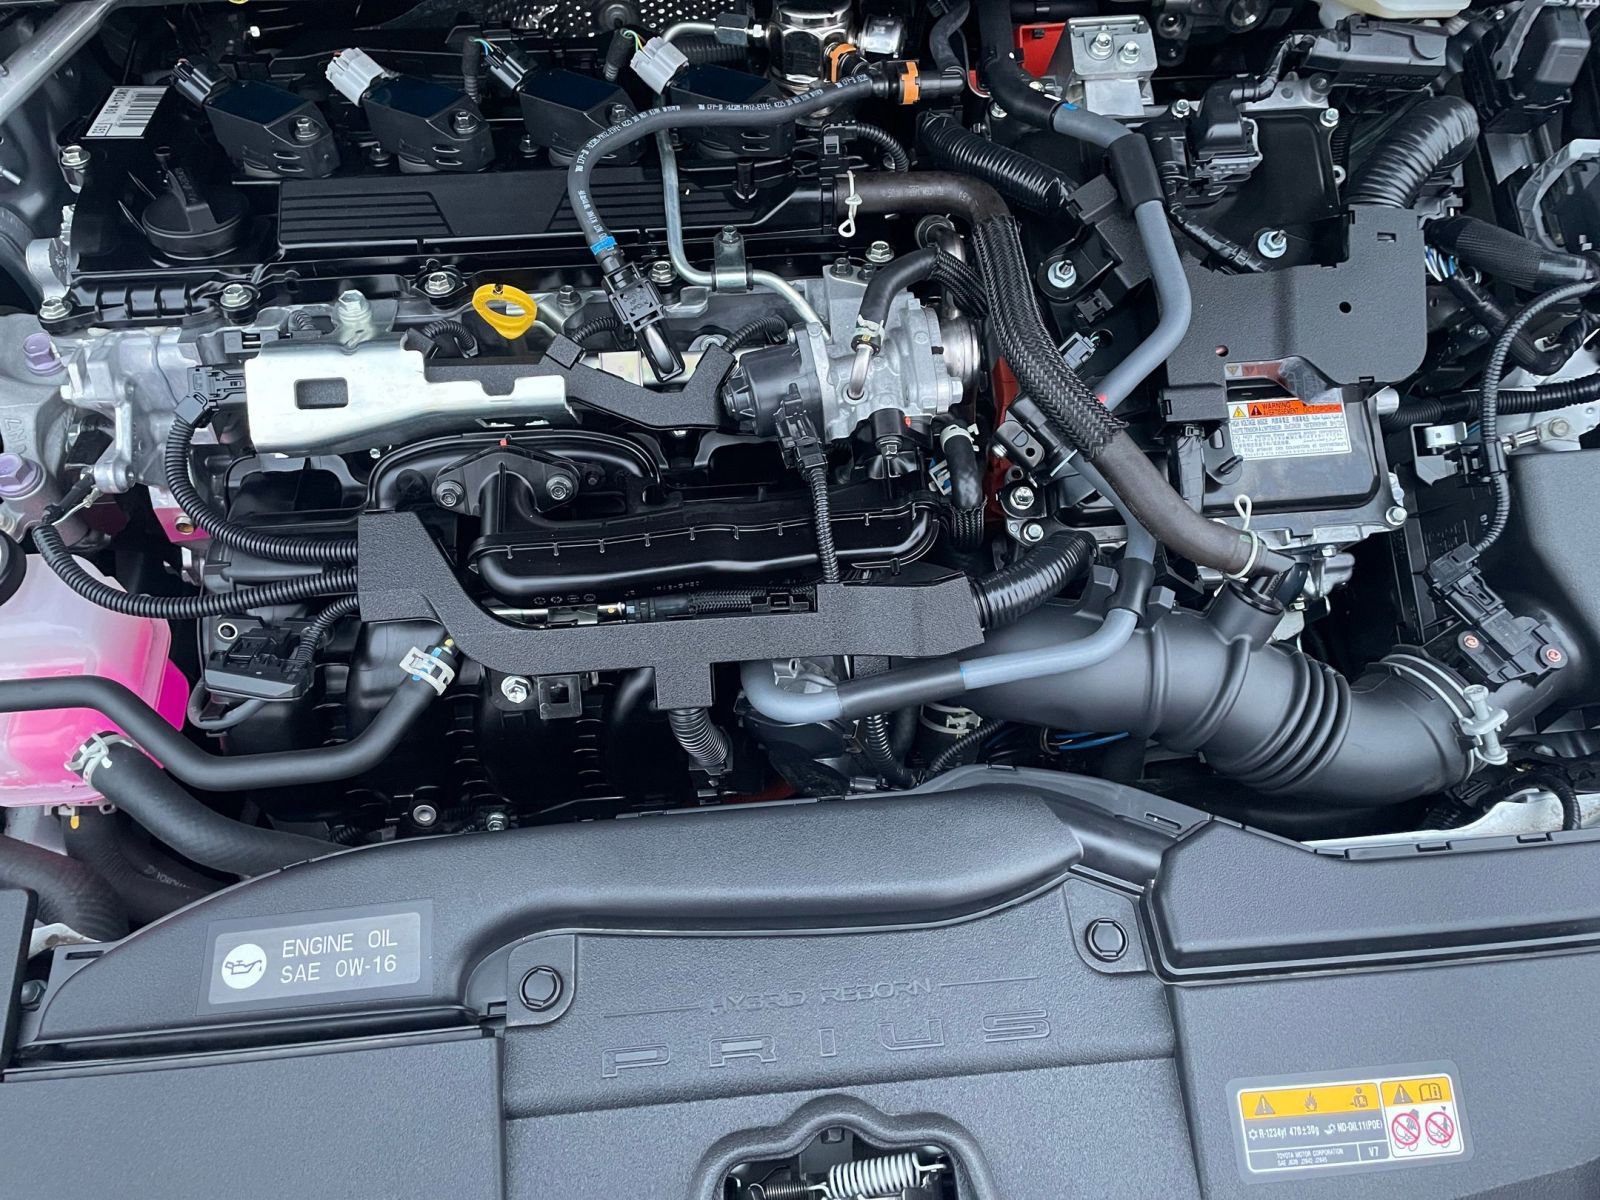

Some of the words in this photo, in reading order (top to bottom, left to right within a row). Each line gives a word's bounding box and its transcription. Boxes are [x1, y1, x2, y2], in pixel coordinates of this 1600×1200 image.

[1262, 400, 1291, 410] WARNING
[282, 932, 354, 958] ENGINE
[368, 928, 399, 949] OIL
[280, 961, 321, 984] SAE
[335, 954, 397, 978] 0W-16
[821, 977, 932, 1002] REBORN
[601, 1009, 1051, 1079] PRIUS
[1276, 1151, 1295, 1160] TOYOTA
[1295, 1150, 1312, 1159] MOTOR
[1312, 1147, 1344, 1157] CORPORATION
[1368, 1145, 1379, 1157] V7
